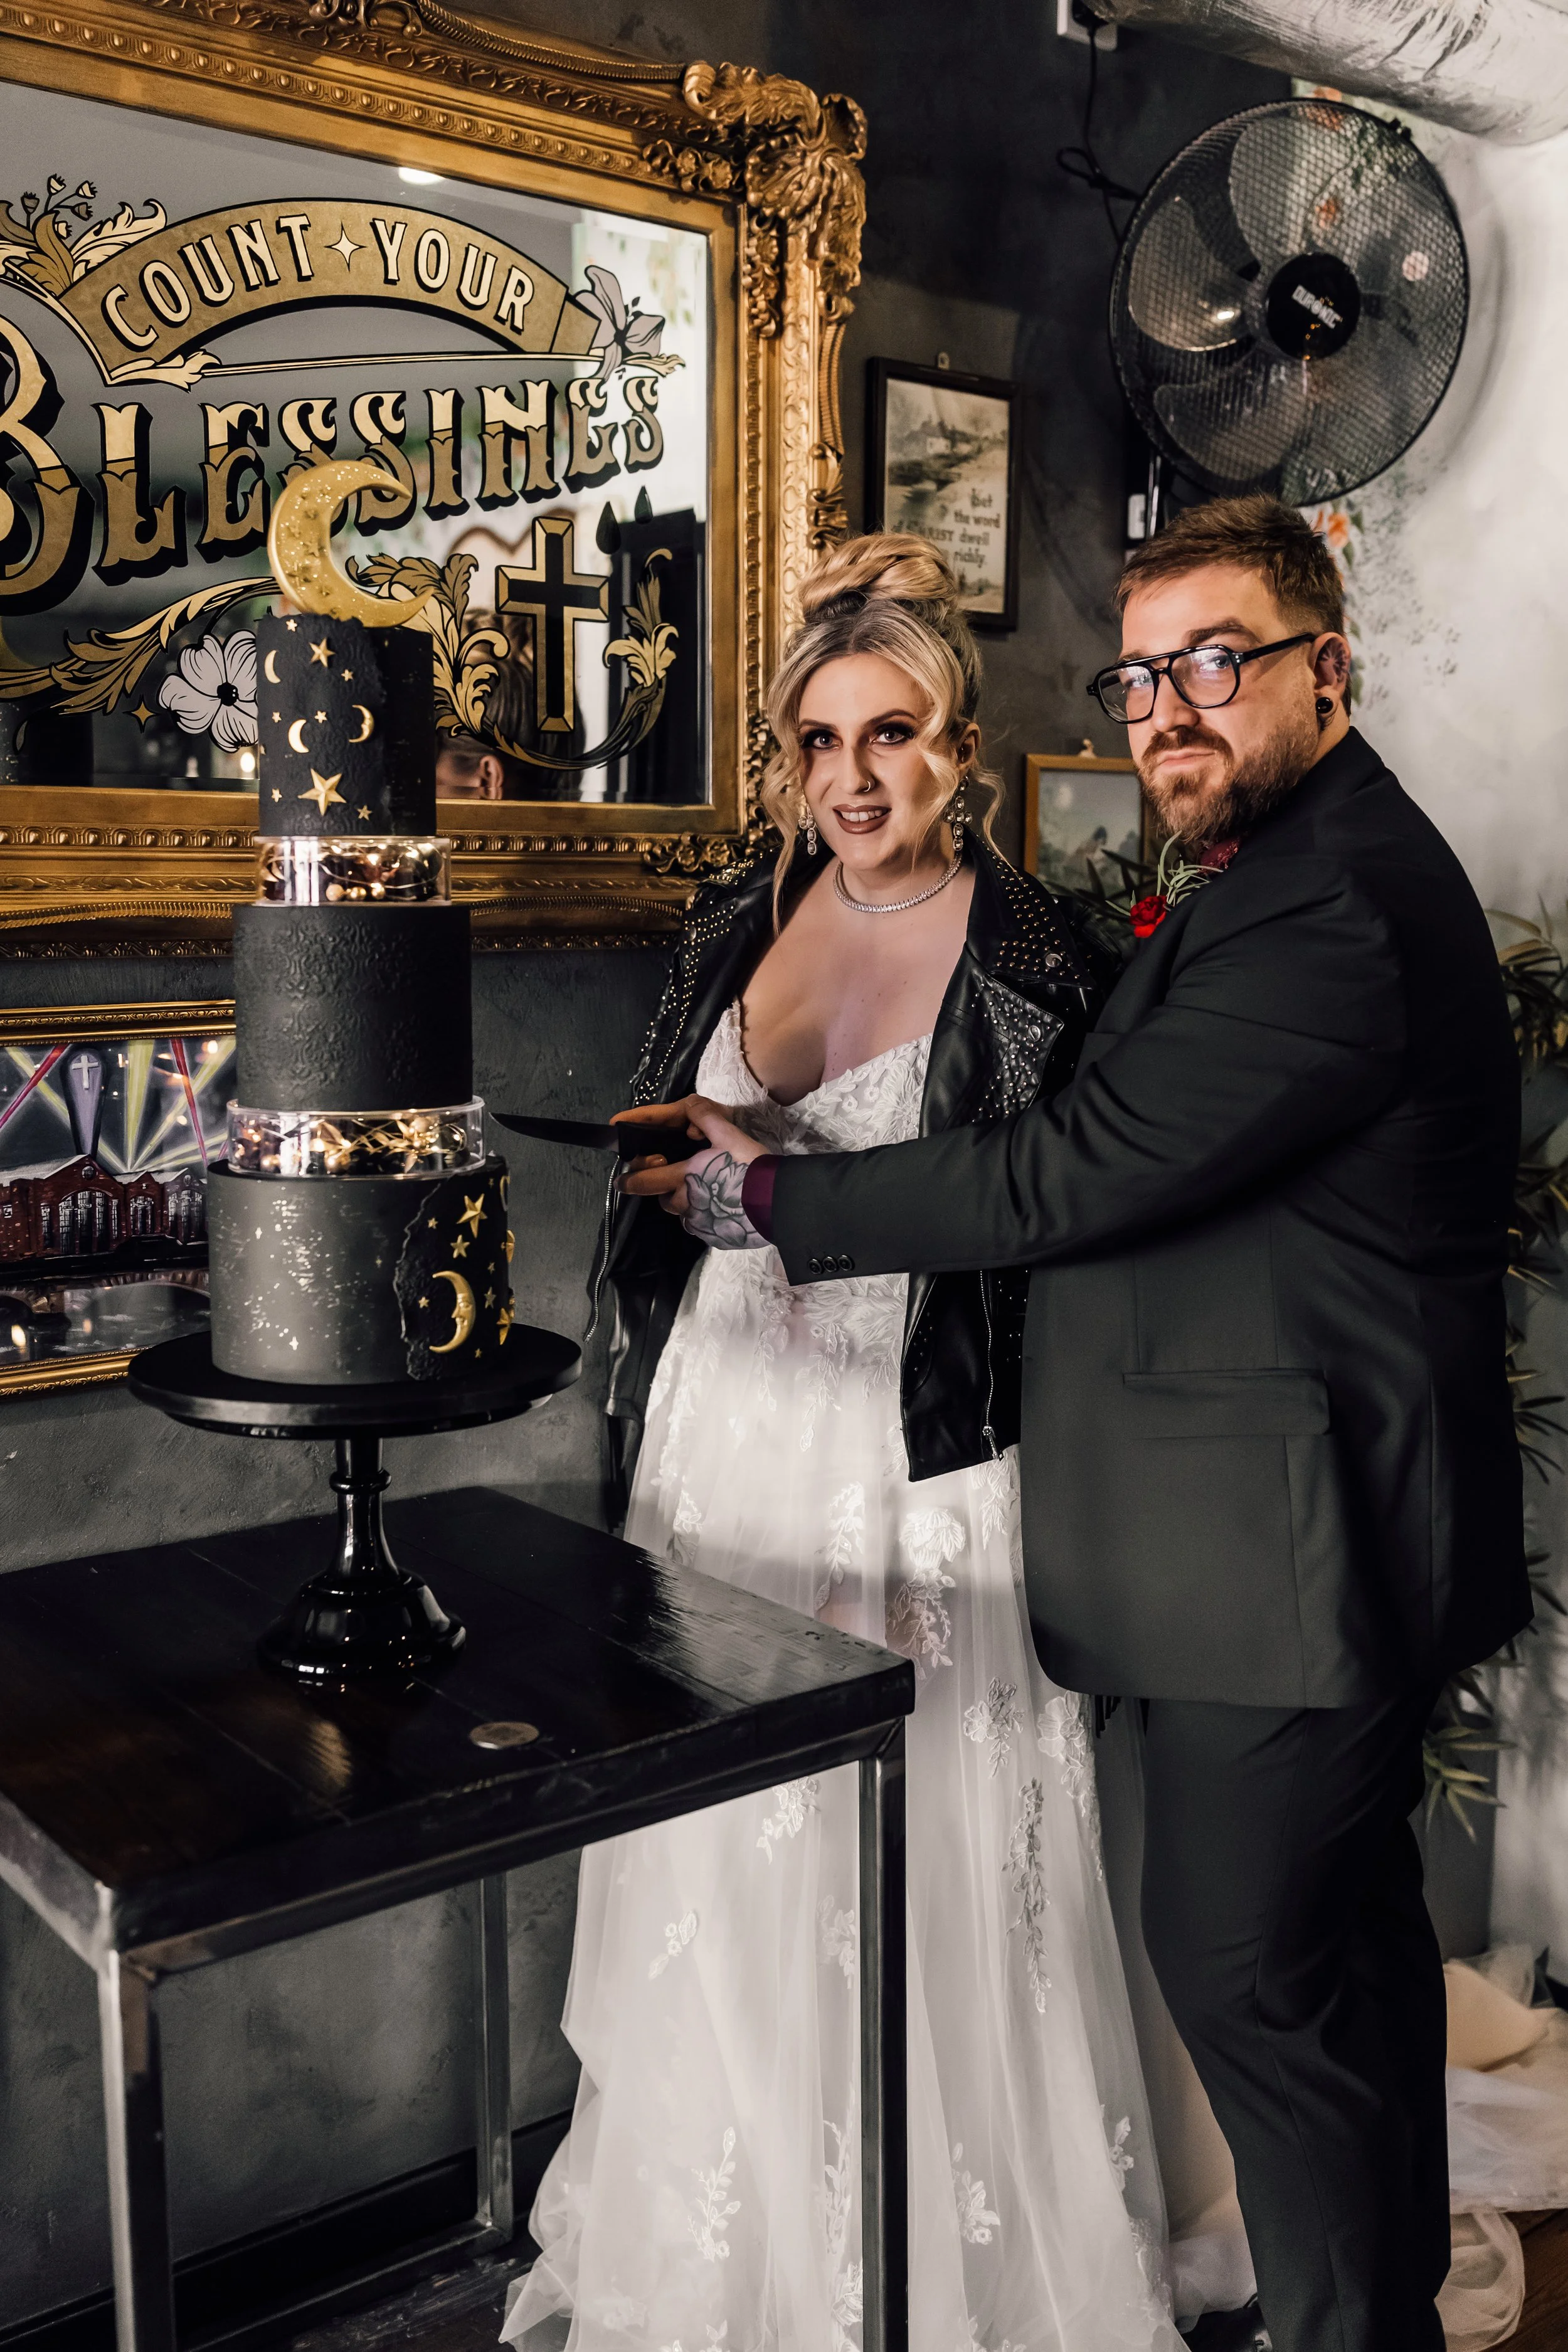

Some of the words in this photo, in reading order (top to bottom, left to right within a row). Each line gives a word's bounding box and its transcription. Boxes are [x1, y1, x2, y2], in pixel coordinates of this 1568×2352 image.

[100, 215, 315, 348] COUNT
[370, 218, 536, 334] YOUR
[972, 512, 1000, 529] word
